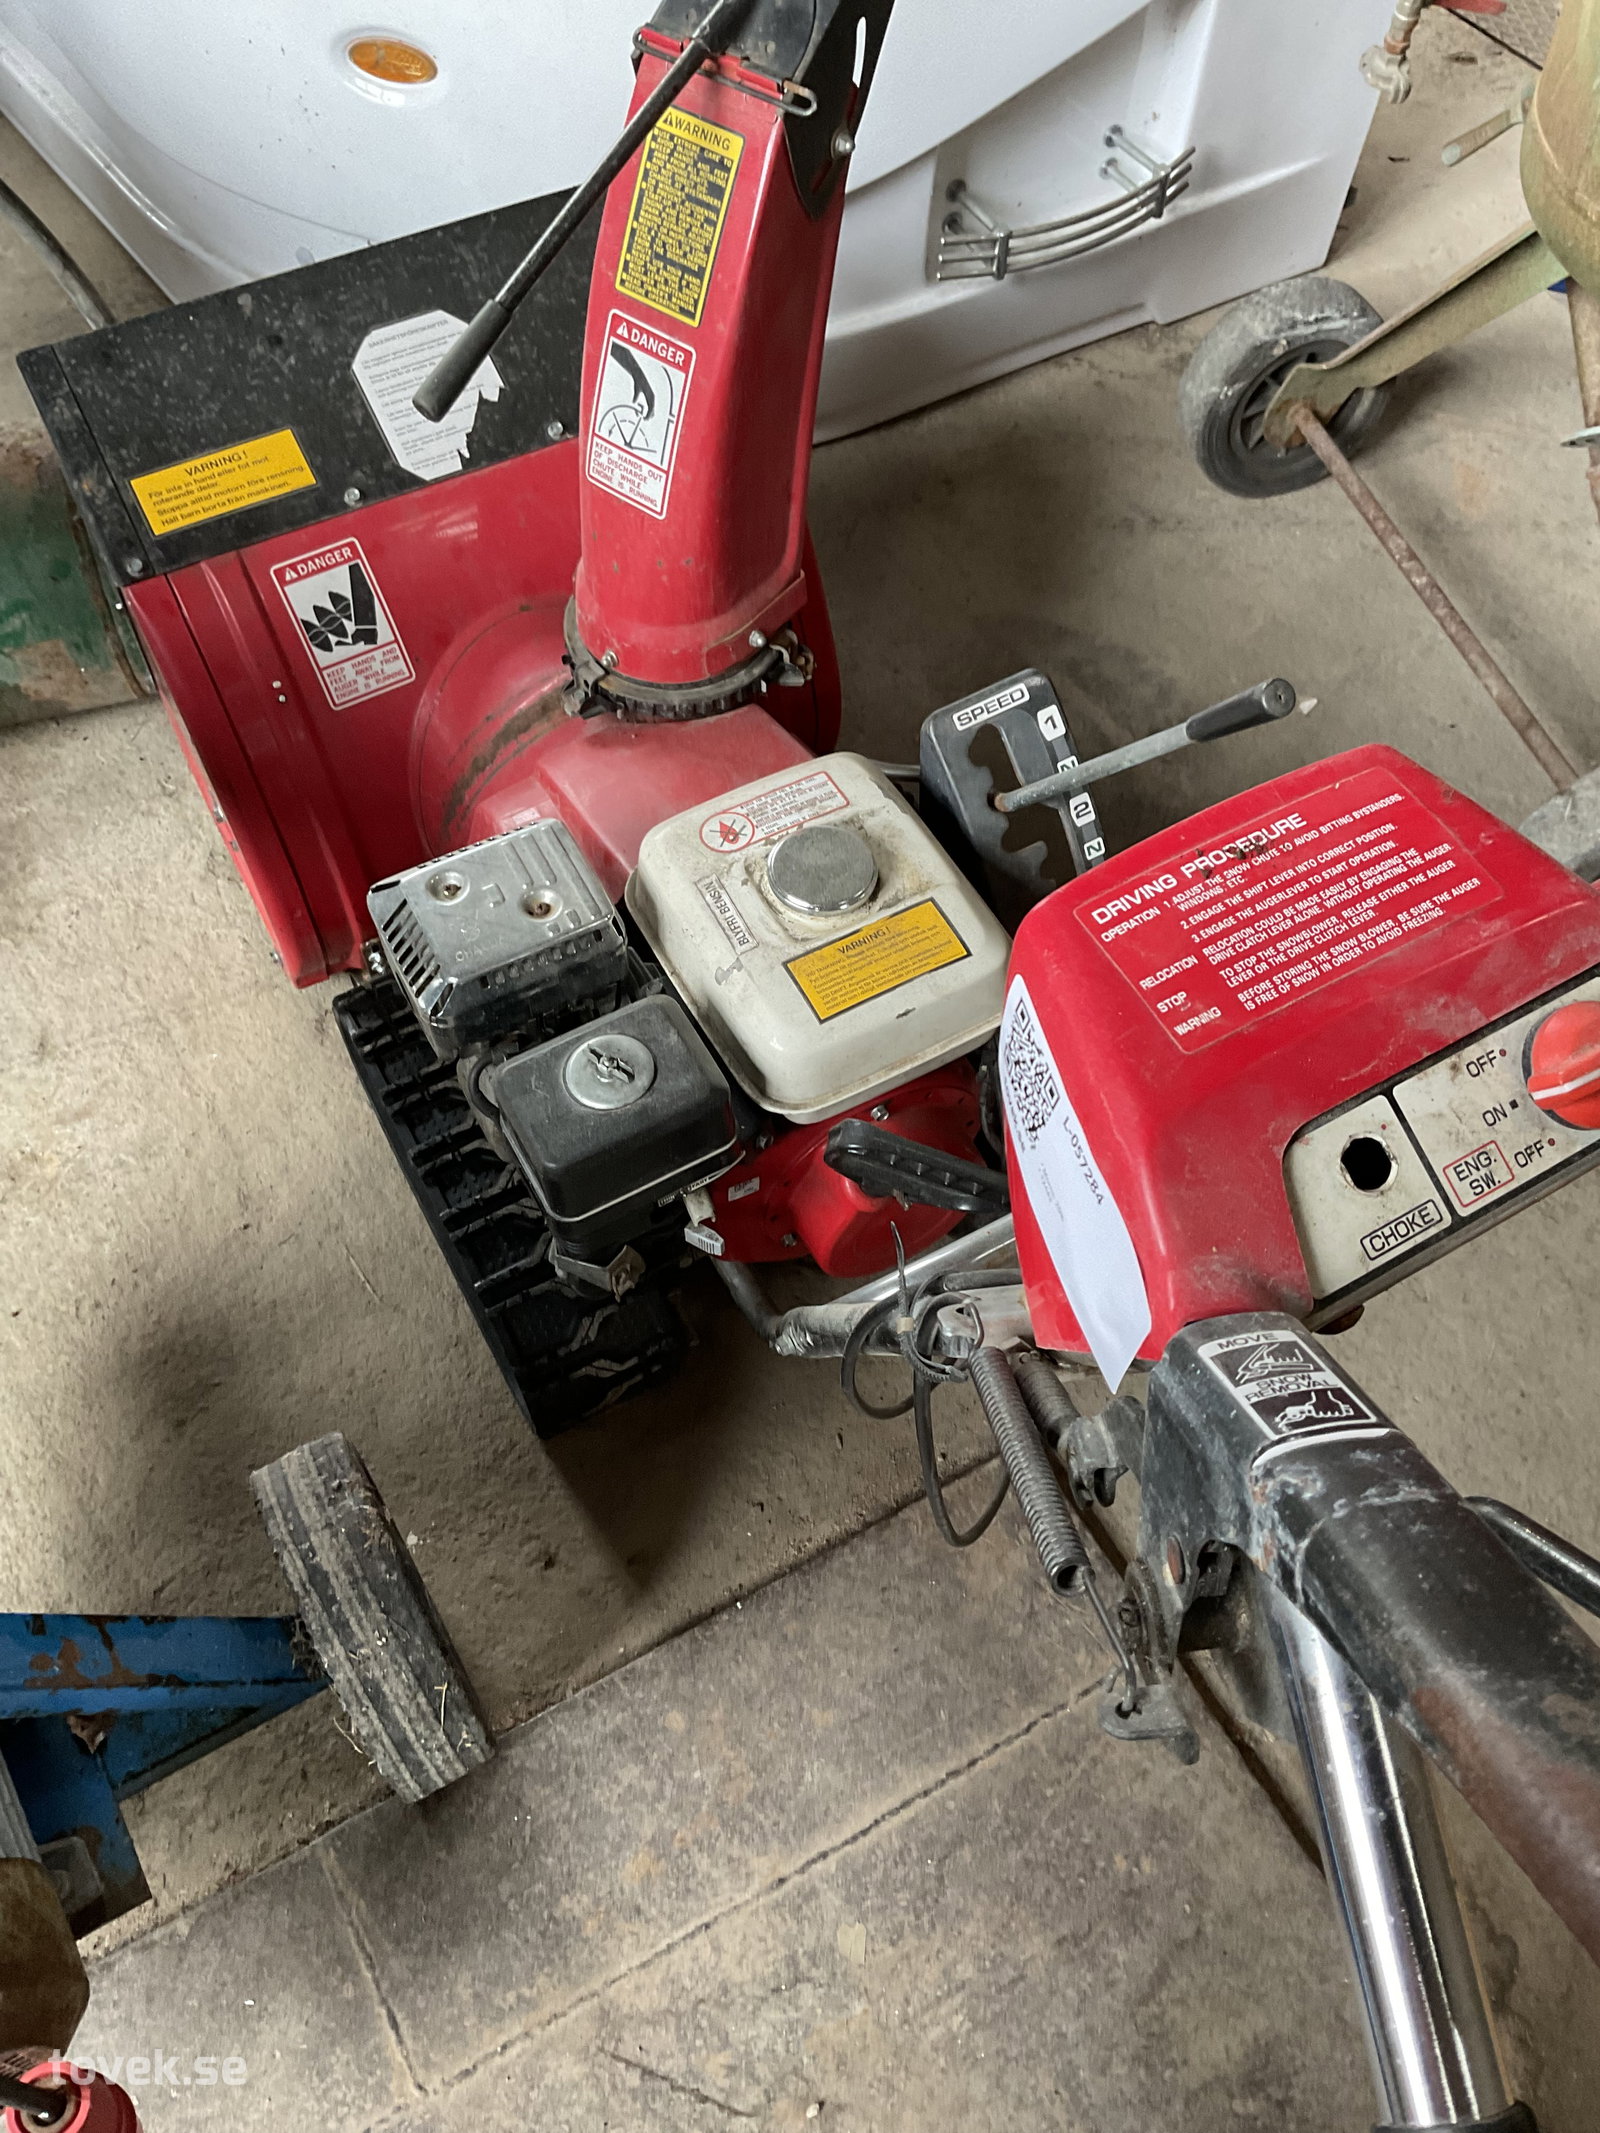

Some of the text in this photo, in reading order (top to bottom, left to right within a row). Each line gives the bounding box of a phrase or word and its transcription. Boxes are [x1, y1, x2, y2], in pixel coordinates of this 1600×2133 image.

[675, 116, 730, 152] WARNING
[630, 329, 684, 367] DANGER
[184, 451, 242, 476] VARNING
[591, 465, 613, 484] ENGINE
[592, 457, 641, 490] CHUTE WHILE
[593, 449, 648, 484] OF DISCHARGE
[594, 440, 663, 483] KEEP HANDS OUT
[193, 472, 216, 485] hand
[297, 546, 353, 576] DANGER
[325, 646, 397, 678] KEEP HANDS AND
[329, 653, 400, 686] FEET AWAY FROM
[332, 667, 385, 693] AUGER WHILE
[335, 686, 360, 701] ENGINE
[957, 688, 1025, 727] SPEED
[1044, 715, 1058, 730] 1
[1074, 802, 1092, 818] 2
[1087, 841, 1102, 856] N
[1206, 875, 1224, 886] THE
[1223, 862, 1250, 878] SNOW
[1252, 849, 1280, 865] CHUTE
[1280, 843, 1292, 852] TO
[1294, 830, 1319, 846] AVOID
[1319, 815, 1353, 834] BITTING
[1224, 894, 1244, 906] THE
[1243, 882, 1268, 898] SHIFT
[1268, 869, 1296, 886] LEVER
[1295, 859, 1317, 873] INTO
[1317, 840, 1355, 862] CORRECT
[1355, 823, 1397, 845] POSITION.
[1091, 813, 1308, 925] DRIVING PROCEDURE
[1235, 907, 1255, 920] THE
[1255, 881, 1309, 912] AUGERLEVER
[1308, 875, 1322, 885] TO
[1322, 862, 1348, 879] START
[1349, 840, 1398, 866] OPERATION.
[703, 881, 750, 946] BLYFRI BENSIN
[1202, 848, 1418, 956] RELOCATION COULD BE MADE EASILY BY ENGAGING THE
[1209, 844, 1454, 964] DRIVE CLATCH LEVER ALONE, WITHOUT OPERATING THE AUGER.
[1101, 907, 1160, 942] OPERATION
[1219, 968, 1234, 978] TO
[1234, 956, 1256, 972] STOP
[1257, 946, 1277, 960] THE
[1342, 896, 1379, 919] RELEASE
[1378, 882, 1409, 901] EITHER
[1408, 873, 1426, 886] THE
[1427, 860, 1455, 878] AUGER
[837, 927, 886, 955] VARNING
[1226, 909, 1378, 987] LEVER OR THE DRIVE CLUTCH LEVER.
[1238, 878, 1480, 1002] BEFORE STORING THE SNOW BLOWER, BE SURE THE AUGER
[1140, 955, 1198, 989] RELOCATION
[1244, 907, 1448, 1010] IS FREE OF SNOW IN ORDER TO AVOID FREEZING.
[1157, 992, 1186, 1012] STOP
[1174, 1007, 1221, 1035] WARNING
[1465, 1049, 1498, 1078] OFF
[1482, 1102, 1508, 1128] ON
[1063, 1116, 1105, 1206] L-057284
[1453, 1150, 1498, 1182] ENG.
[1514, 1140, 1546, 1169] OFF
[1468, 1172, 1502, 1197] SW.
[1368, 1206, 1435, 1254] CHOKE
[1217, 1332, 1278, 1350] MOVE
[1244, 1380, 1338, 1402] REMOVAL
[1256, 1373, 1312, 1389] SNOW
